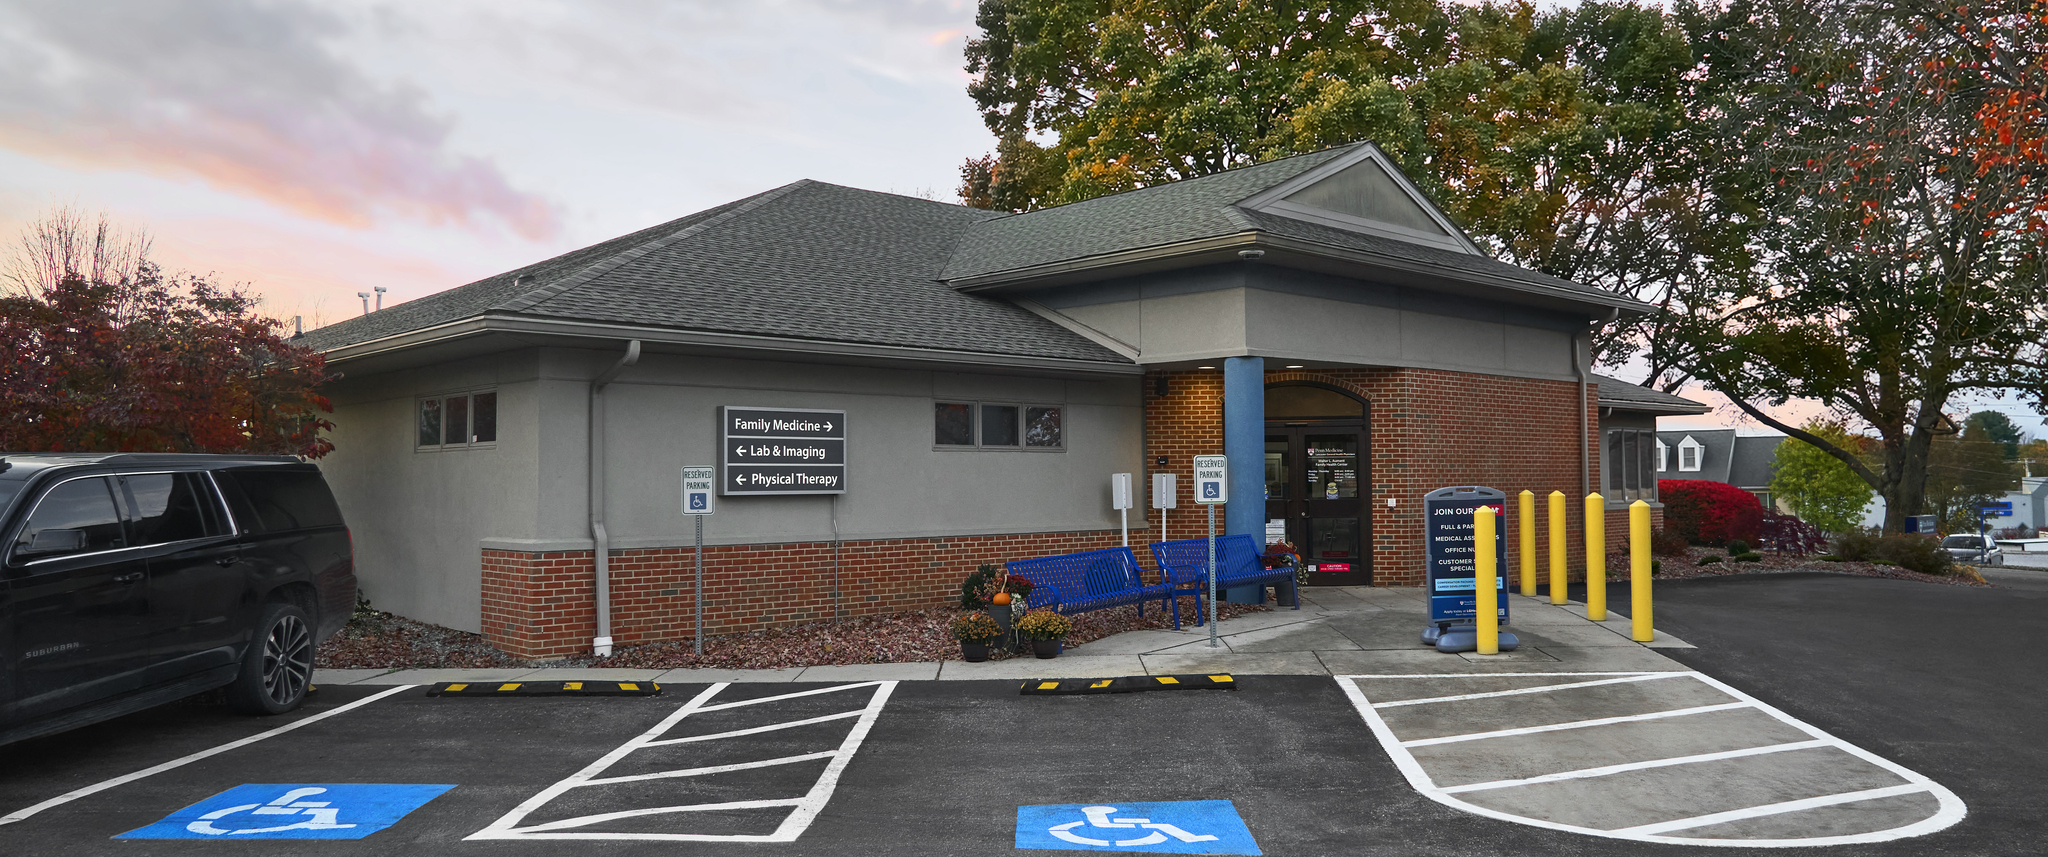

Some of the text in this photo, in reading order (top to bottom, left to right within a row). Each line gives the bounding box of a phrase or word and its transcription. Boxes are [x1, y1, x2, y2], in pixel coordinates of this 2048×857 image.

[735, 418, 820, 433] Family Medicine
[750, 444, 826, 459] Lab & Imaging
[1197, 460, 1224, 468] RESERVED
[684, 470, 712, 479] RESERVED
[1200, 470, 1222, 478] PARKING
[751, 473, 838, 487] Physical Therapy
[686, 481, 710, 490] PARKING
[1434, 508, 1453, 516] JOIN
[1456, 507, 1474, 515] OUR
[25, 641, 80, 659] SUBURBAN
